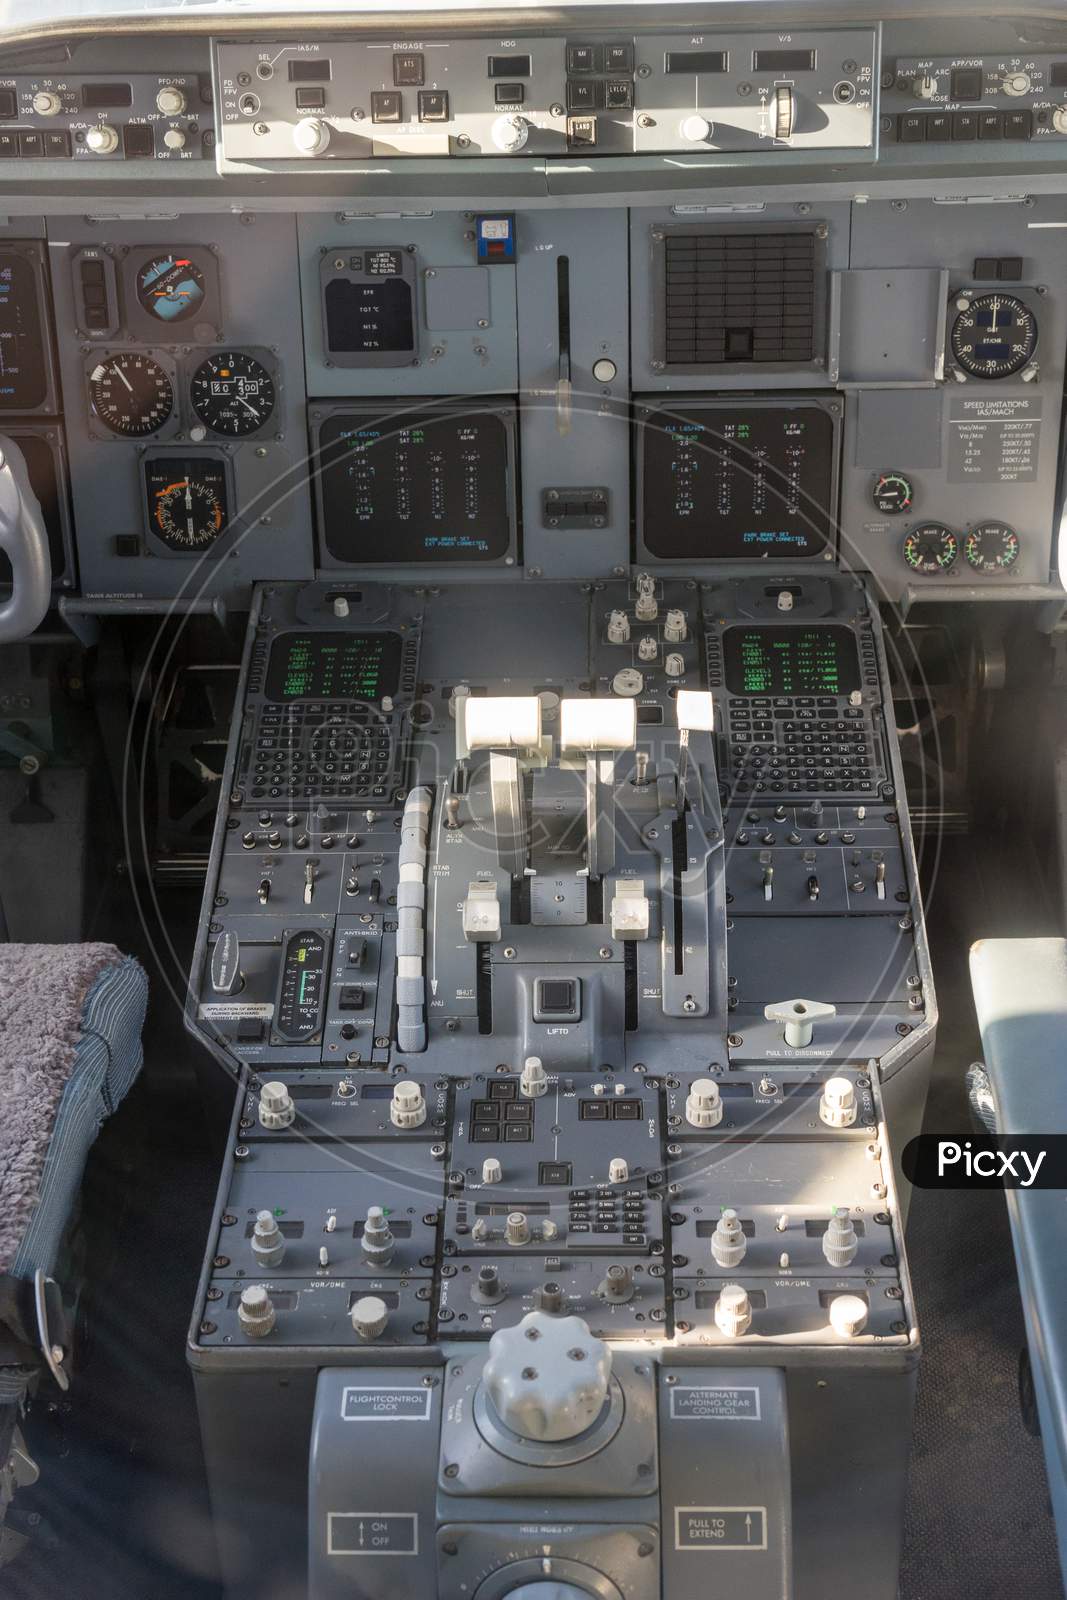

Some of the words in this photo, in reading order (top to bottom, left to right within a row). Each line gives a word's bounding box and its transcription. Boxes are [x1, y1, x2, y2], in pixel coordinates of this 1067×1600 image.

[1016, 318, 1024, 326] 10
[962, 344, 972, 352] 40
[1012, 344, 1022, 352] 20
[228, 360, 235, 368] 0
[986, 360, 996, 368] 30
[202, 380, 208, 388] 8
[258, 378, 264, 386] 2
[963, 401, 984, 409] SPEED
[986, 400, 1029, 408] LIMITATIONS
[977, 408, 1015, 416] IAS/MACH
[349, 1395, 423, 1403] FLIGHTCONTROL
[689, 1391, 739, 1399] ALTERNATE
[371, 1522, 388, 1532] ON
[689, 1519, 710, 1528] PULL
[711, 1519, 725, 1528] TO
[689, 1529, 725, 1538] EXTEND
[372, 1536, 390, 1546] OFF
